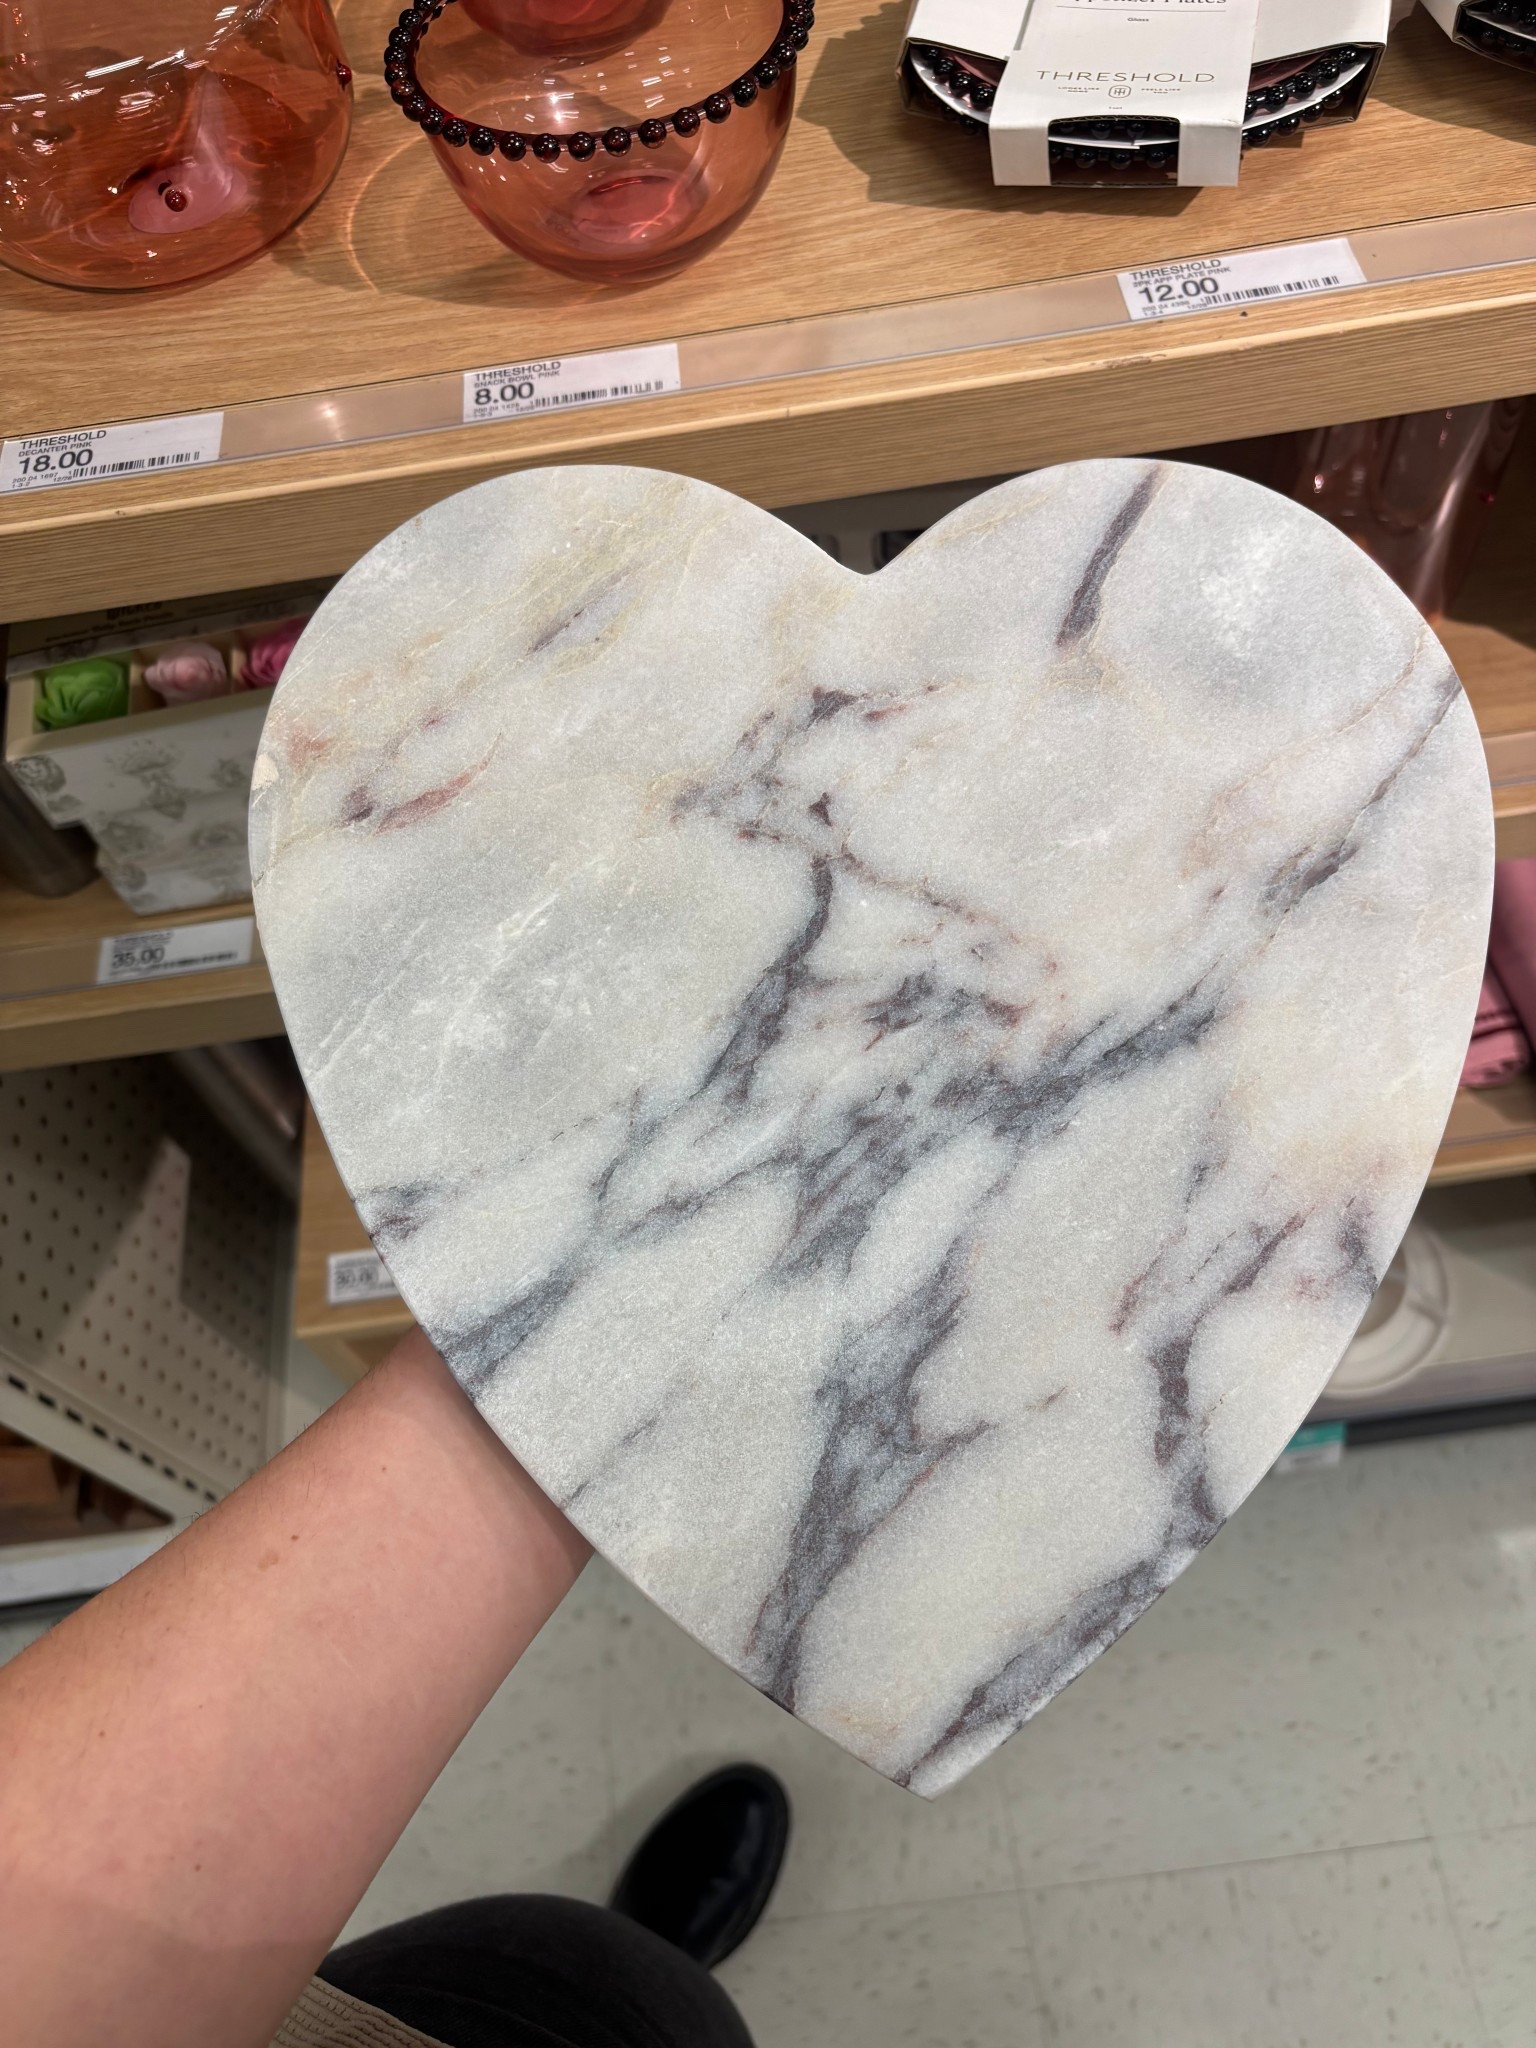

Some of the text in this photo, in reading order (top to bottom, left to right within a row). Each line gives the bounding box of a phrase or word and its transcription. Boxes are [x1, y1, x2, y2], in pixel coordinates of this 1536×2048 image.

[1037, 70, 1215, 83] THRESHOLD
[1130, 259, 1221, 280] THRESHOLD
[1154, 276, 1173, 284] APP
[1175, 270, 1206, 280] PLATE
[1207, 266, 1231, 275] PINK
[1138, 277, 1219, 304] 12.00
[474, 361, 561, 381] THRESHOLD
[474, 379, 506, 388] SNACK
[508, 375, 536, 383] BOWL
[475, 381, 534, 405] 8.00
[19, 441, 92, 457] DECANTER PINK
[21, 430, 107, 450] THRESHOLD
[19, 448, 94, 474] 18.00
[112, 946, 165, 969] 35.00
